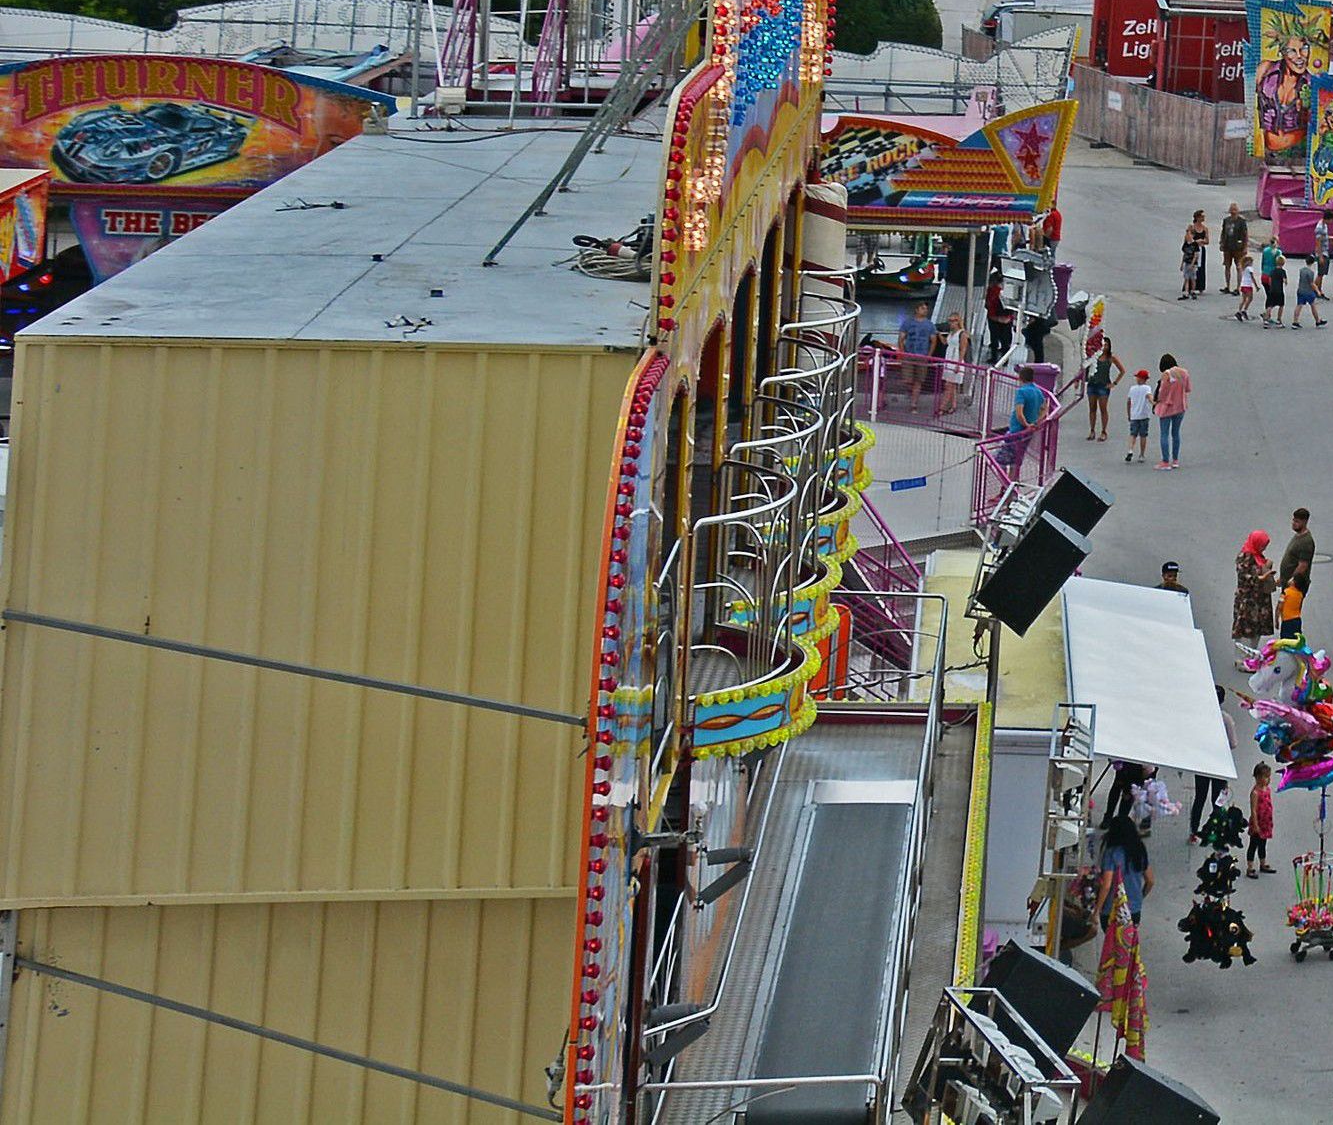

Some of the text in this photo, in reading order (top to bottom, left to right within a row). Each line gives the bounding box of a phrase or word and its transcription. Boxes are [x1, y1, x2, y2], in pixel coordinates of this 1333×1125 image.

[1122, 19, 1158, 36] Zelt
[1122, 41, 1151, 59] Lig
[1215, 41, 1243, 60] elt
[1218, 63, 1245, 80] igh
[17, 59, 301, 129] THURNER
[104, 210, 162, 235] THE
